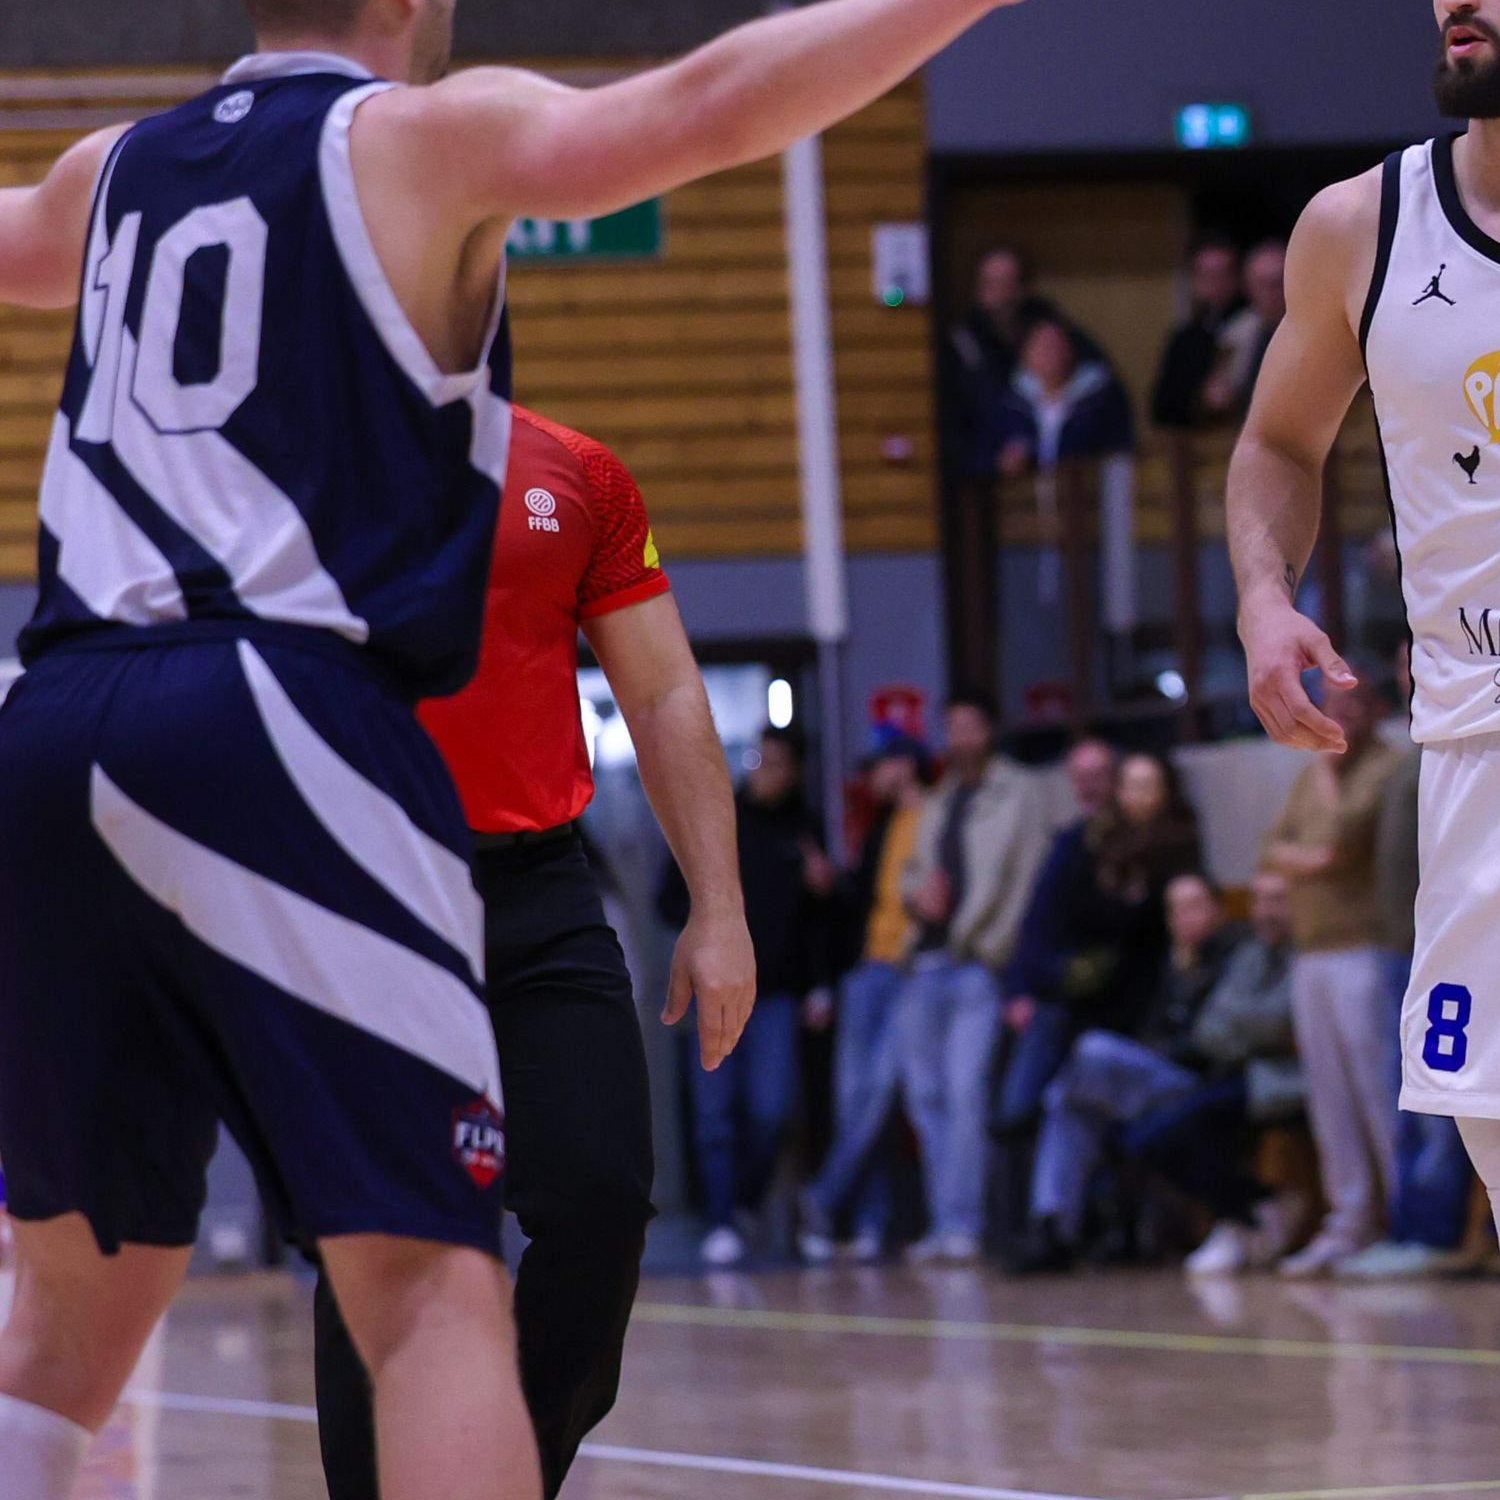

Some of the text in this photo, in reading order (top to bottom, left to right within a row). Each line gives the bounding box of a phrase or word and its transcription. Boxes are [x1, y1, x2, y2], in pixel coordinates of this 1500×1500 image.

[75, 196, 269, 443] 10
[528, 515, 560, 533] FFBB
[1422, 982, 1472, 1073] 8
